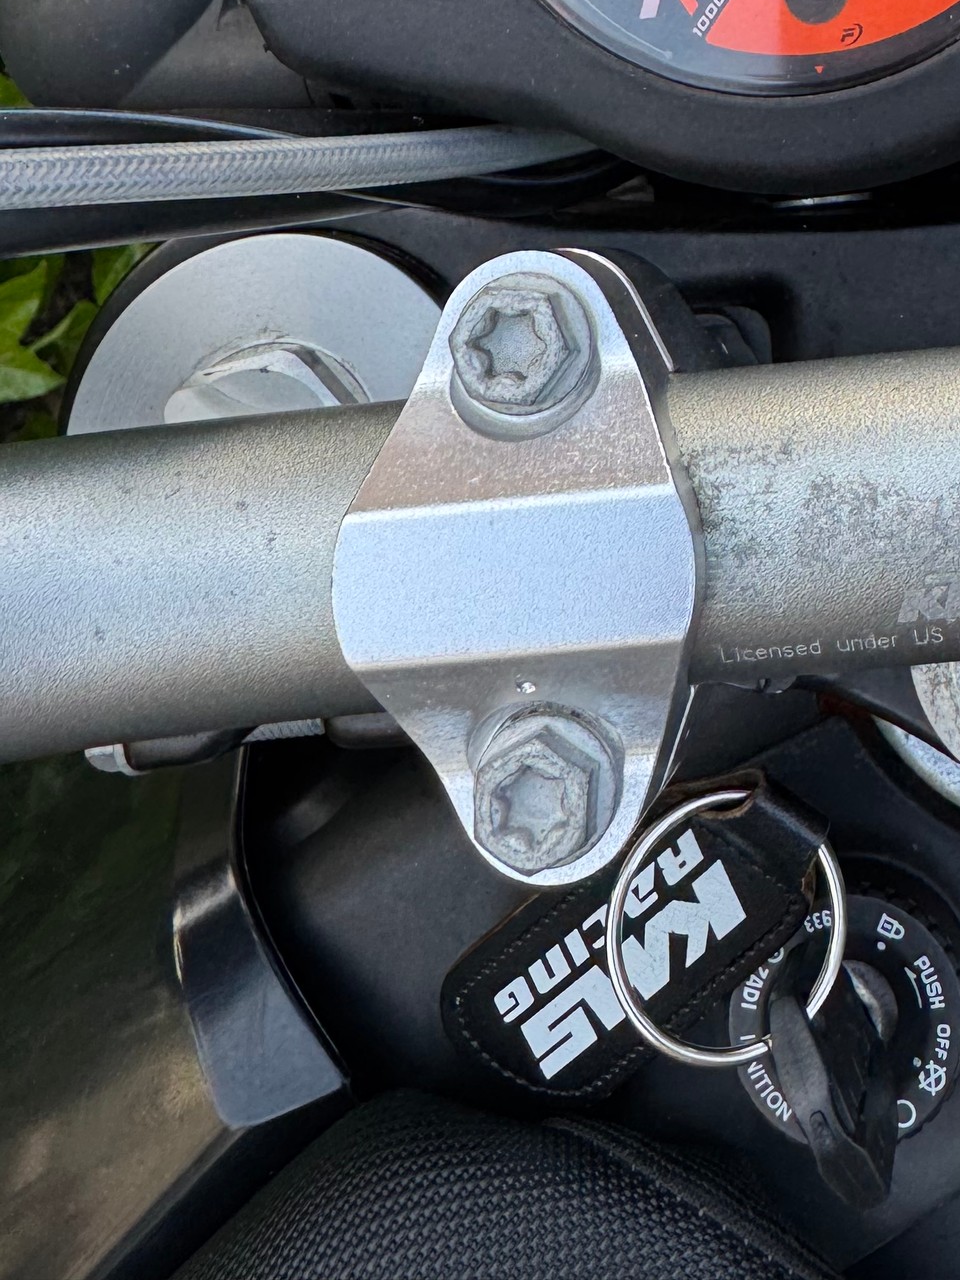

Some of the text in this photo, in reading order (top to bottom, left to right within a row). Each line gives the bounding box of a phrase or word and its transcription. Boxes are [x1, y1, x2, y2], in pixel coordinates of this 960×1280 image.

[720, 639, 822, 663] Licensed
[835, 633, 898, 653] under
[913, 625, 944, 646] US
[913, 955, 945, 1009] PUSH
[935, 1023, 950, 1061] OFF
